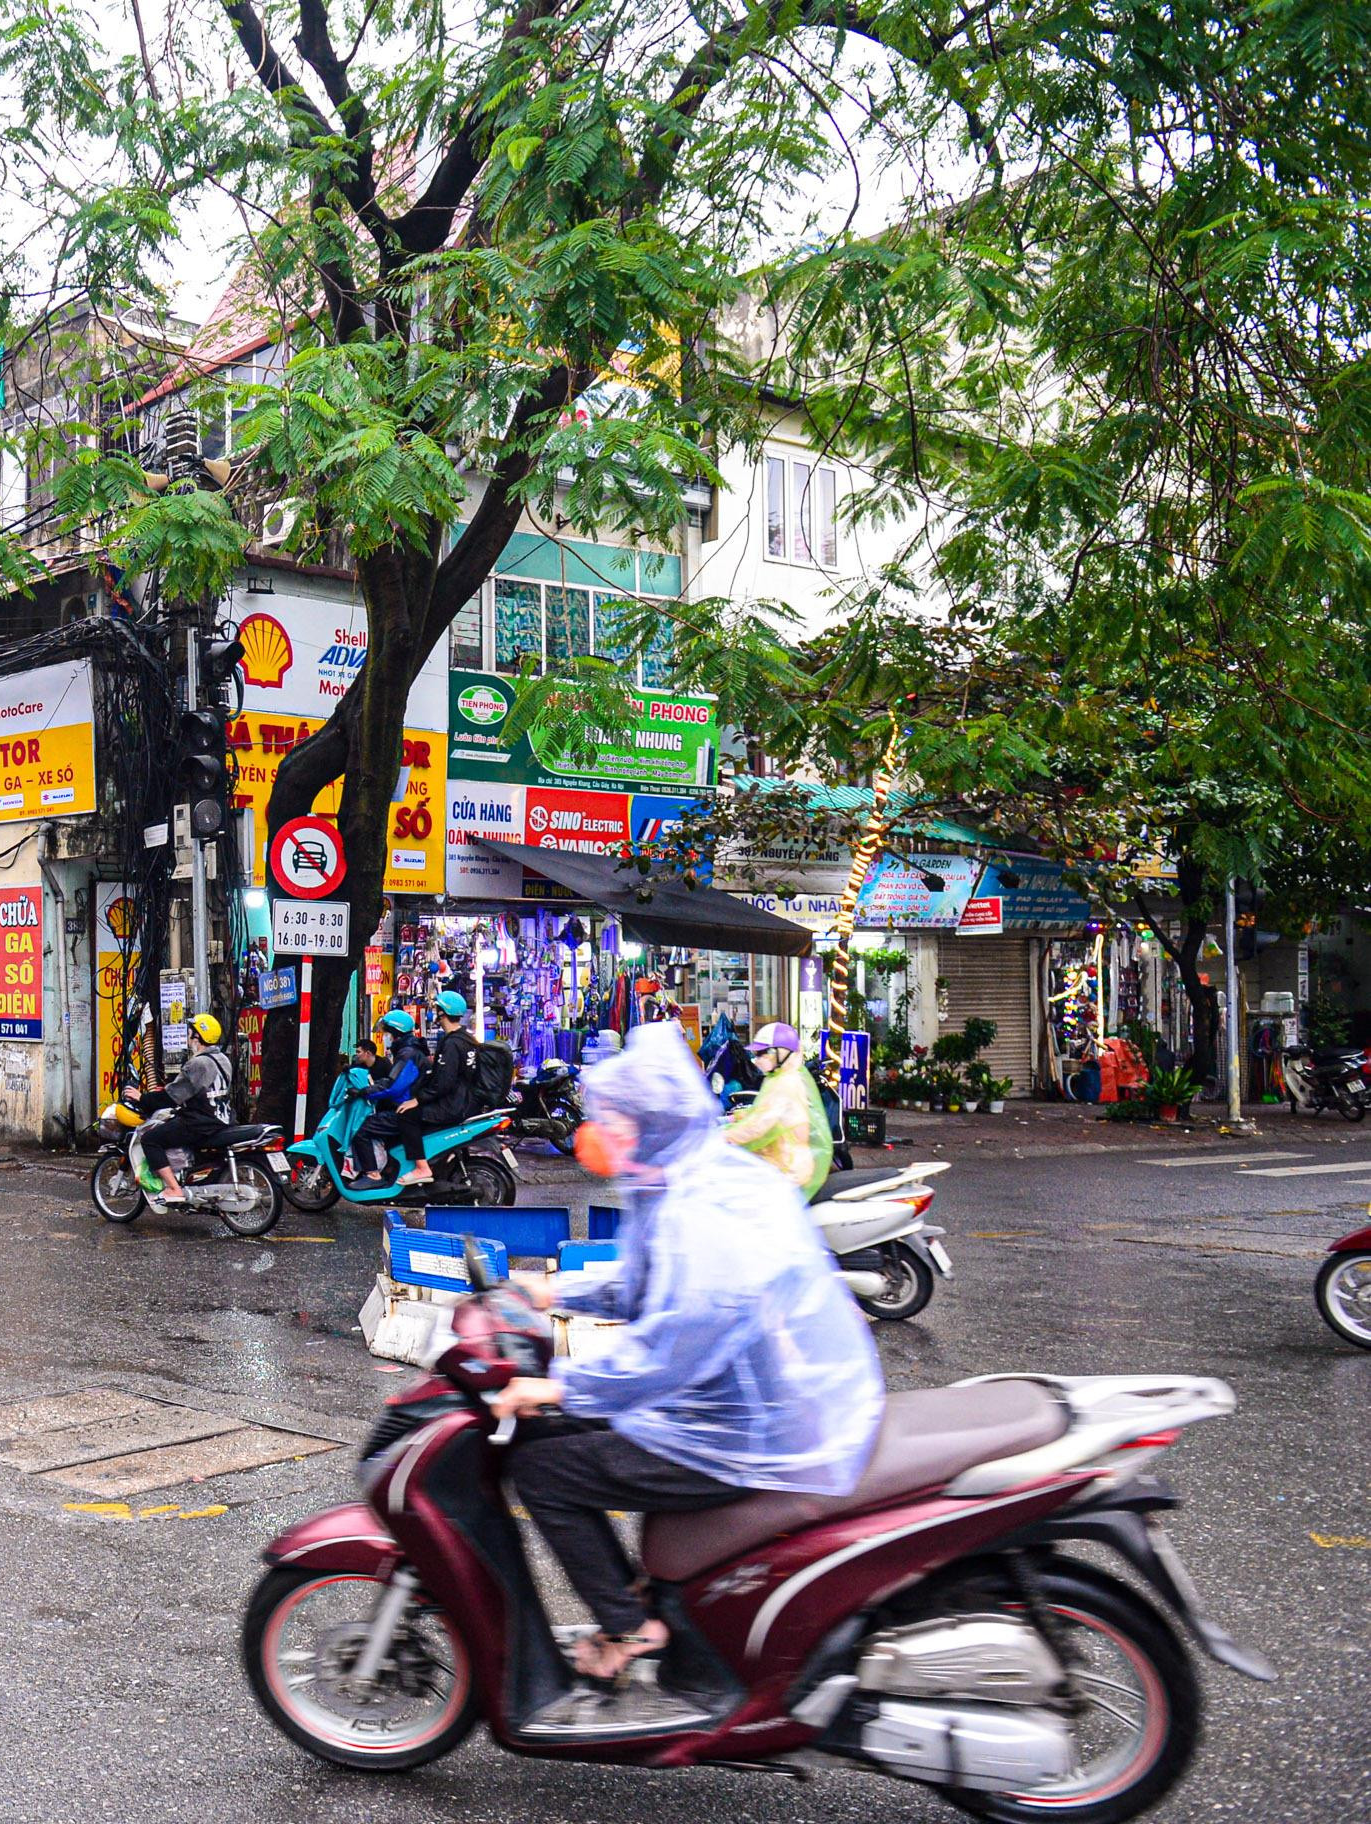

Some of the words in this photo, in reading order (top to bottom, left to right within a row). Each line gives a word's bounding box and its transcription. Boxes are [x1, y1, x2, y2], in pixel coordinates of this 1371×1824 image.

[335, 629, 366, 648] Shell
[319, 680, 348, 697] Mot
[649, 702, 709, 724] PHONG
[635, 730, 682, 751] NHUNG
[4, 775, 23, 791] GA
[38, 771, 53, 785] XE
[57, 763, 74, 784] SỐ
[393, 797, 432, 840] SỐ
[453, 795, 476, 820] CỬA
[480, 800, 512, 823] HÀNG
[550, 811, 582, 831] SINO
[582, 818, 624, 834] ELECTRIC
[447, 827, 479, 846] OÀNG
[920, 859, 952, 869] GARDEN
[389, 879, 403, 887] 0983
[283, 911, 308, 926] 6:30
[319, 913, 343, 927] 8:30
[5, 932, 34, 954] GA
[5, 957, 35, 985] SỐ
[263, 975, 278, 992] NGÕ
[279, 976, 291, 989] 381
[1, 1023, 13, 1034] 571
[15, 1023, 28, 1035] 041
[238, 1010, 259, 1034] SỬA
